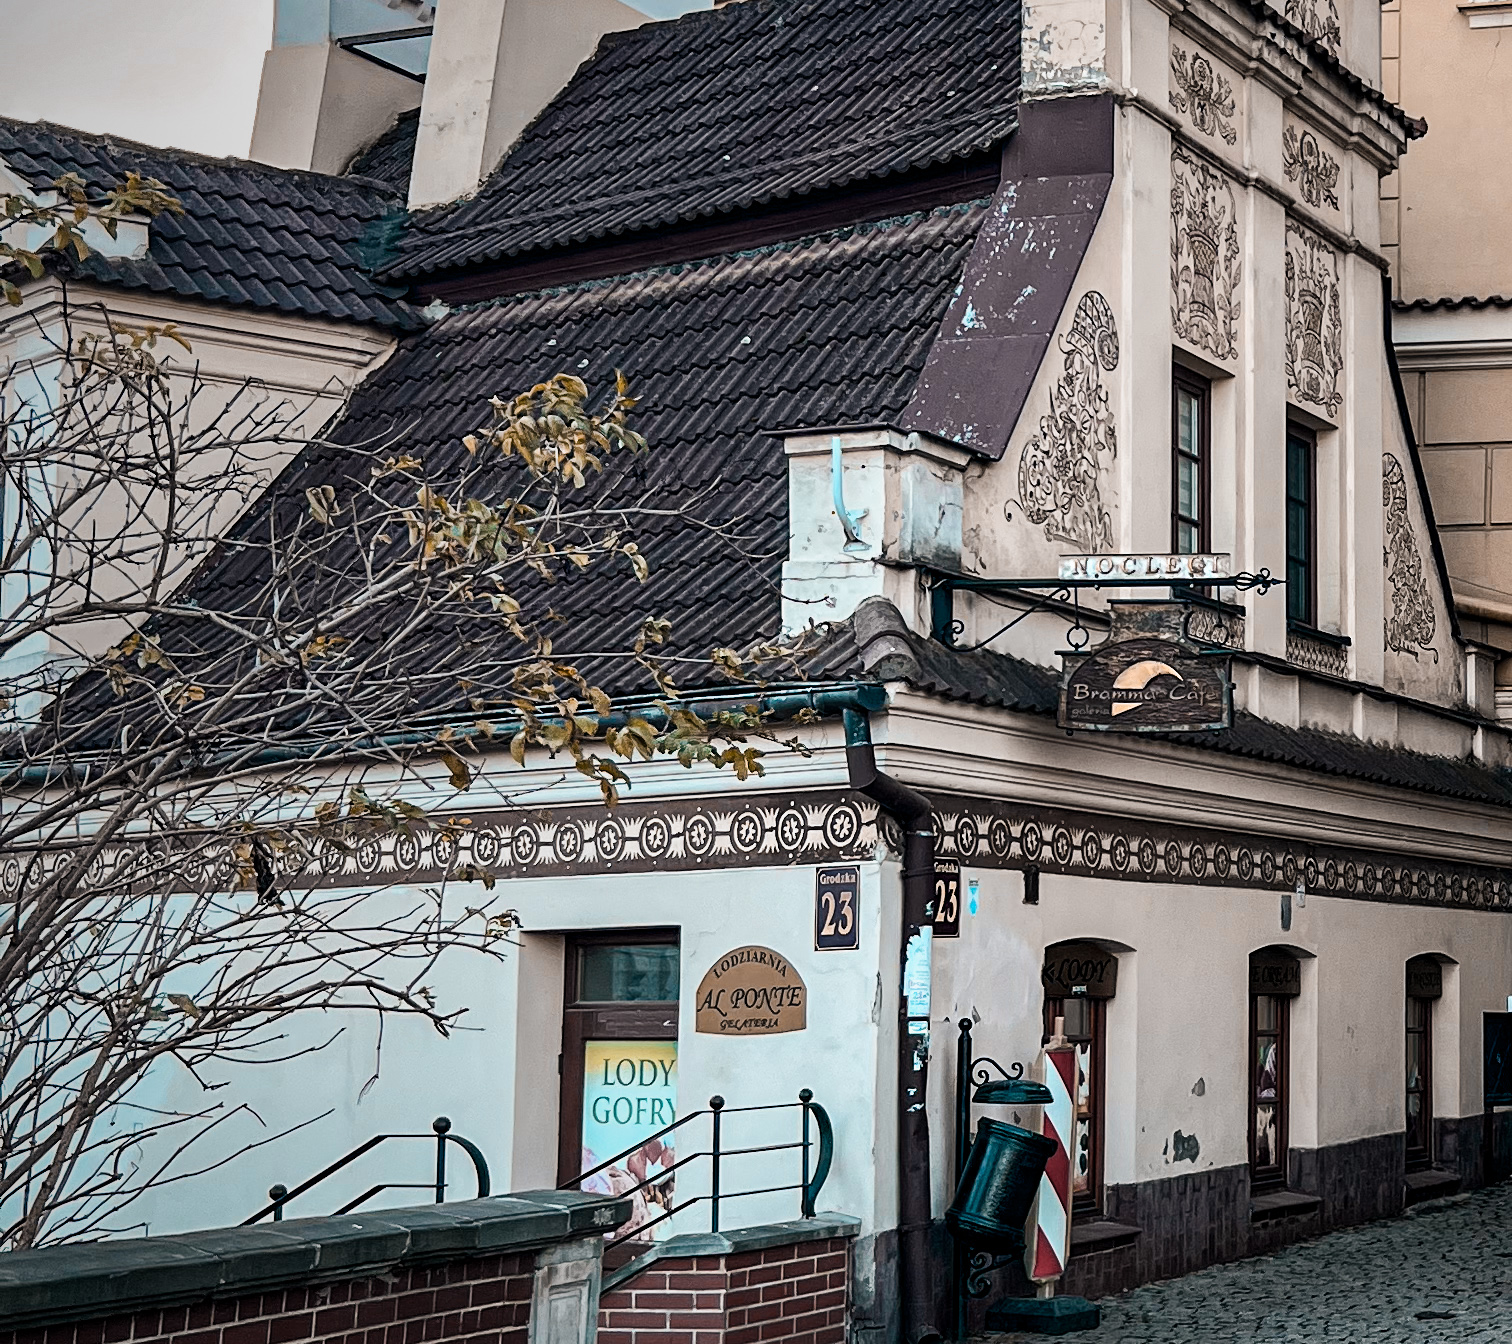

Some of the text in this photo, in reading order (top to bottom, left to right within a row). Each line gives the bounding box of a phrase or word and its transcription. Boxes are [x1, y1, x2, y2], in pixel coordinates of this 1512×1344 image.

[1072, 557, 1220, 575] NOCLEGI
[1073, 684, 1157, 700] Bramma
[820, 872, 856, 884] Grodzka
[821, 892, 854, 936] 23
[934, 880, 958, 923] 23
[713, 950, 788, 979] LODZIARNIA
[697, 985, 802, 1016] AL PONTE
[720, 1018, 778, 1031] GELATERIA
[602, 1058, 676, 1086] LODY
